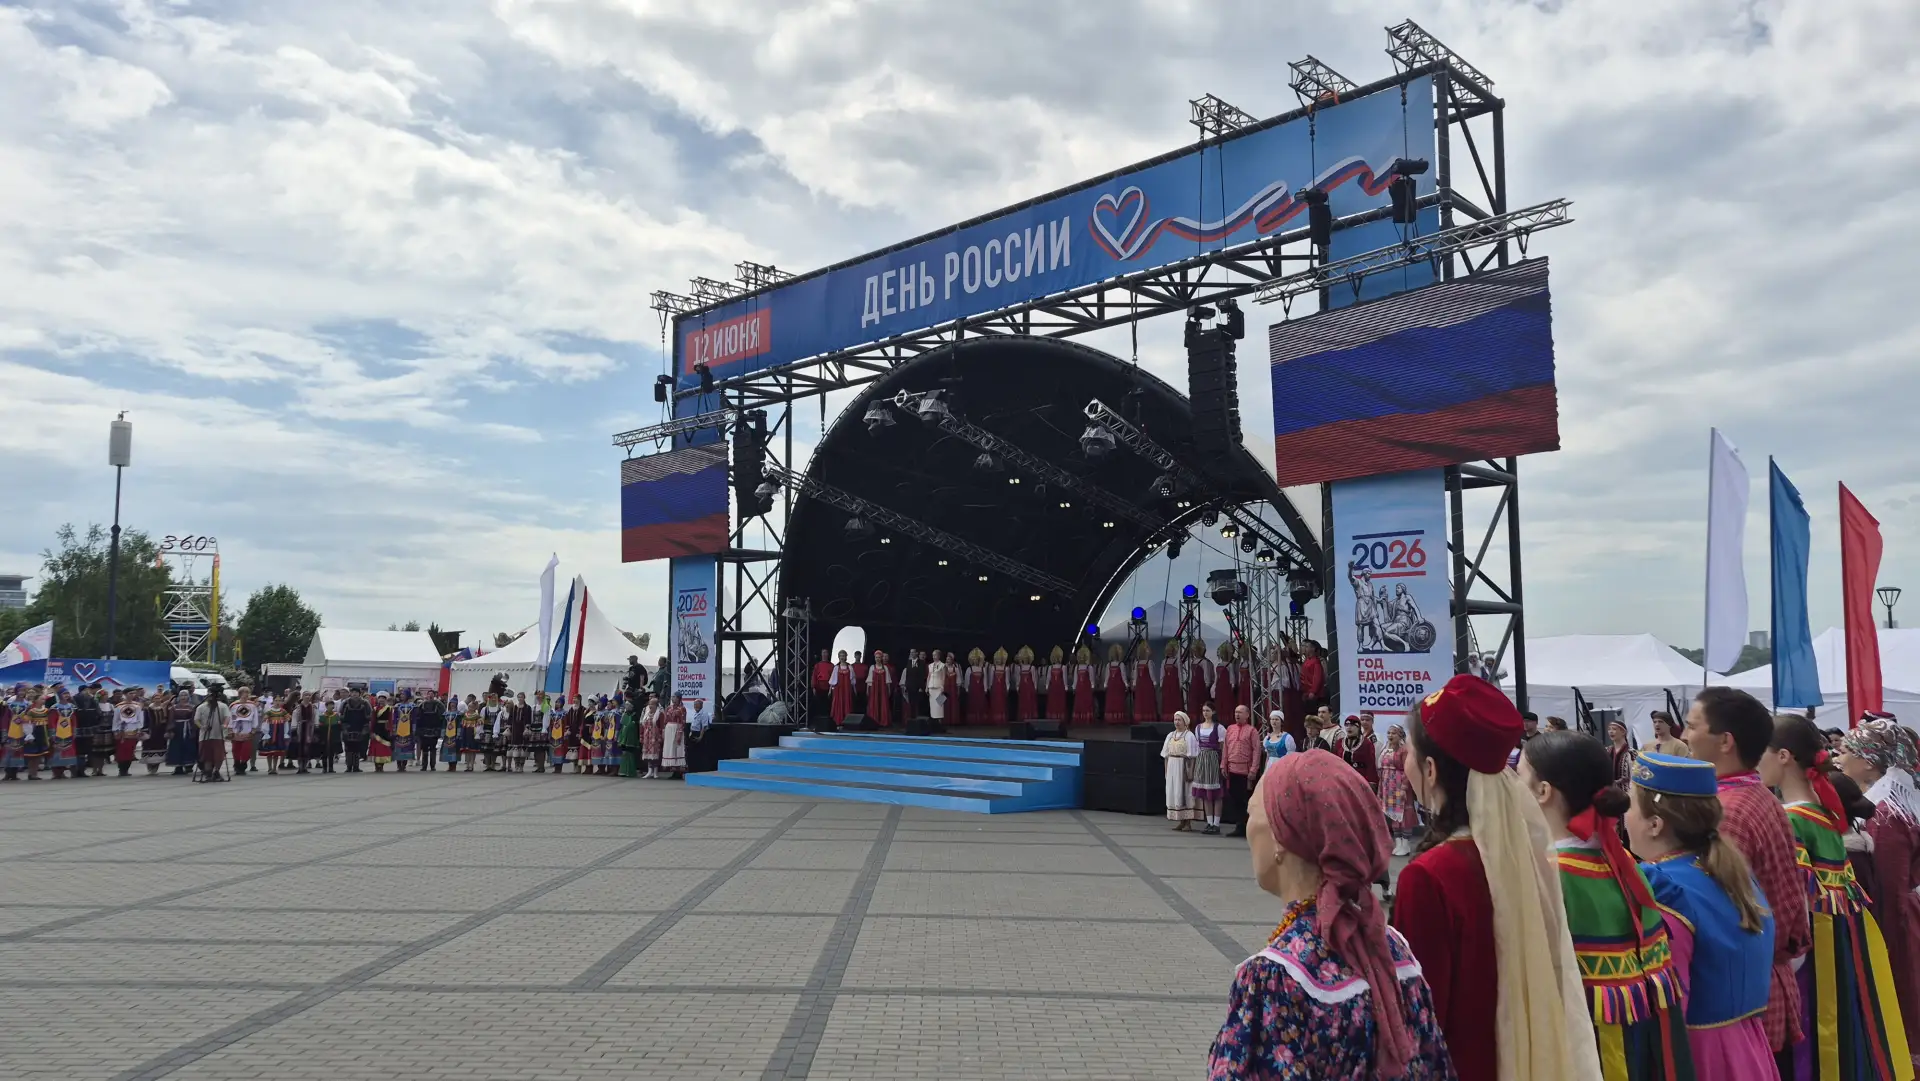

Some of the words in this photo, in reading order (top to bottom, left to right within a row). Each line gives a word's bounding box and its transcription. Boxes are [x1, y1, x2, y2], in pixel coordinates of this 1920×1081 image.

[861, 261, 935, 329] ДЕНЬ
[944, 216, 1070, 300] РОССИИ
[694, 333, 710, 365] 12
[713, 317, 760, 360] ИЮНЯ
[1352, 538, 1426, 571] 2026
[678, 592, 707, 612] 2026
[1357, 657, 1384, 670] ГОД
[677, 673, 706, 681] ЕДИНСТВА
[1358, 670, 1432, 683] ЕДИНСТВА
[677, 681, 703, 689] НАРОДОВ
[1359, 683, 1424, 696] НАРОДОВ
[1359, 696, 1416, 707] РОССИИ
